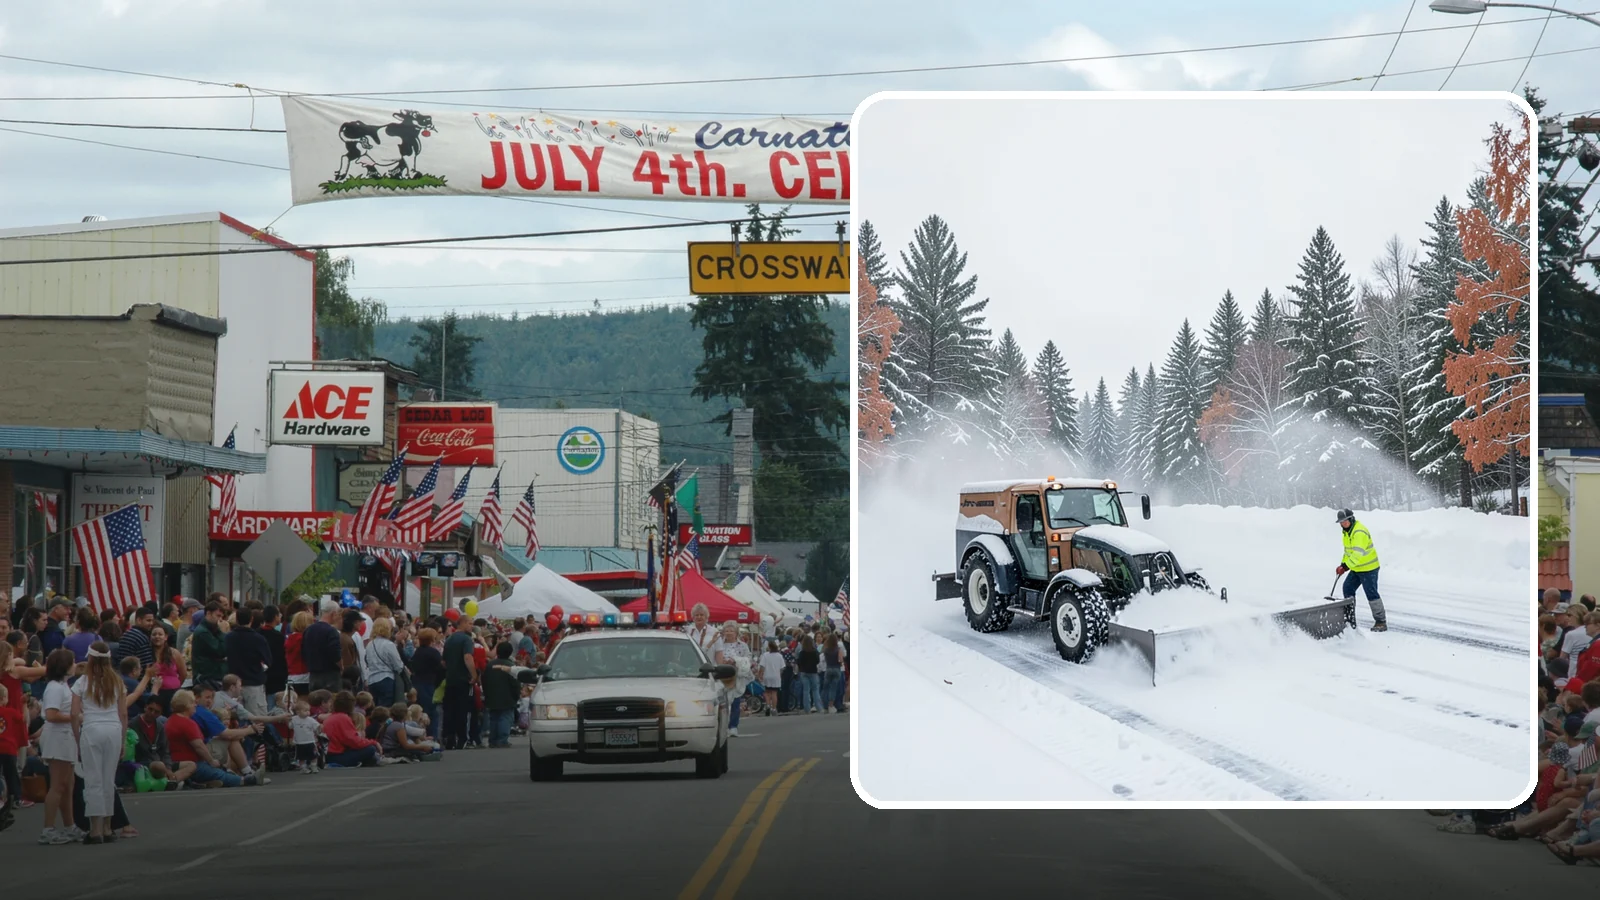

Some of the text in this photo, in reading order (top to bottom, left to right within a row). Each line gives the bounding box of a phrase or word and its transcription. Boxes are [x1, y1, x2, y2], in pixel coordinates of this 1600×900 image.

[695, 121, 850, 150] Carnat
[481, 141, 605, 192] JULY
[632, 150, 746, 198] 4th.
[697, 254, 850, 280] CROSSWA
[283, 380, 373, 420] ACE
[405, 409, 485, 421] CEDAR LOG
[283, 421, 371, 436] Hardware
[416, 428, 477, 447] Coca-Cola
[96, 485, 124, 495] Vincent
[126, 485, 136, 495] de
[138, 486, 155, 495] Paul
[213, 516, 331, 535] HARDARE
[688, 526, 742, 535] CRNATION
[699, 535, 730, 543] GLASS
